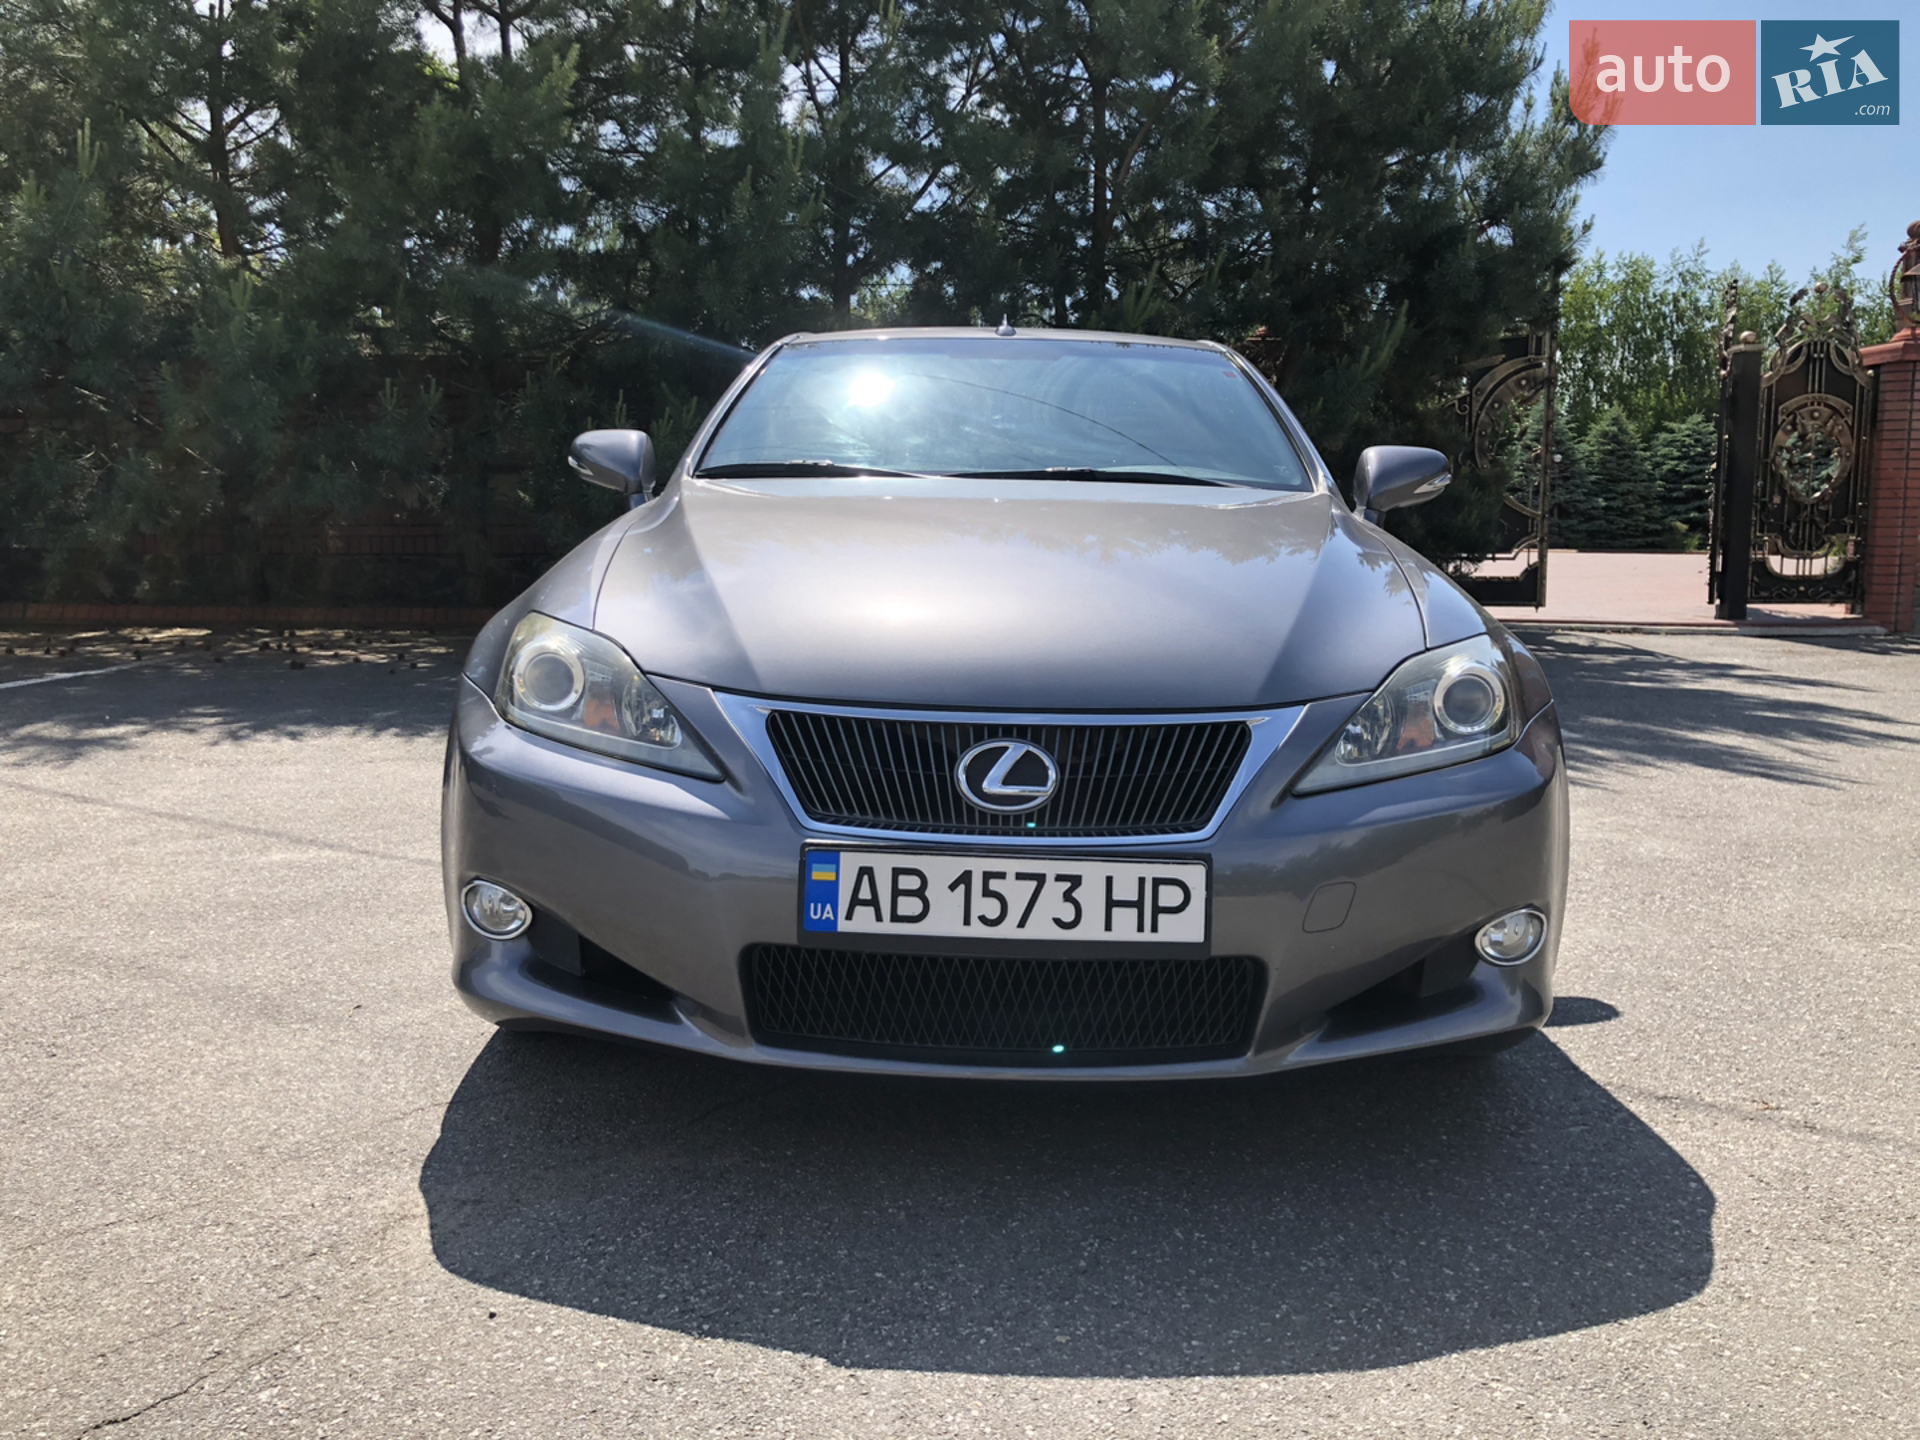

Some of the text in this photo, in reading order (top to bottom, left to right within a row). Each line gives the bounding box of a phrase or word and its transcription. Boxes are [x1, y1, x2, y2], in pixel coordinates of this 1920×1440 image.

[809, 902, 835, 921] UA
[844, 866, 1192, 934] AB 1573 HP
